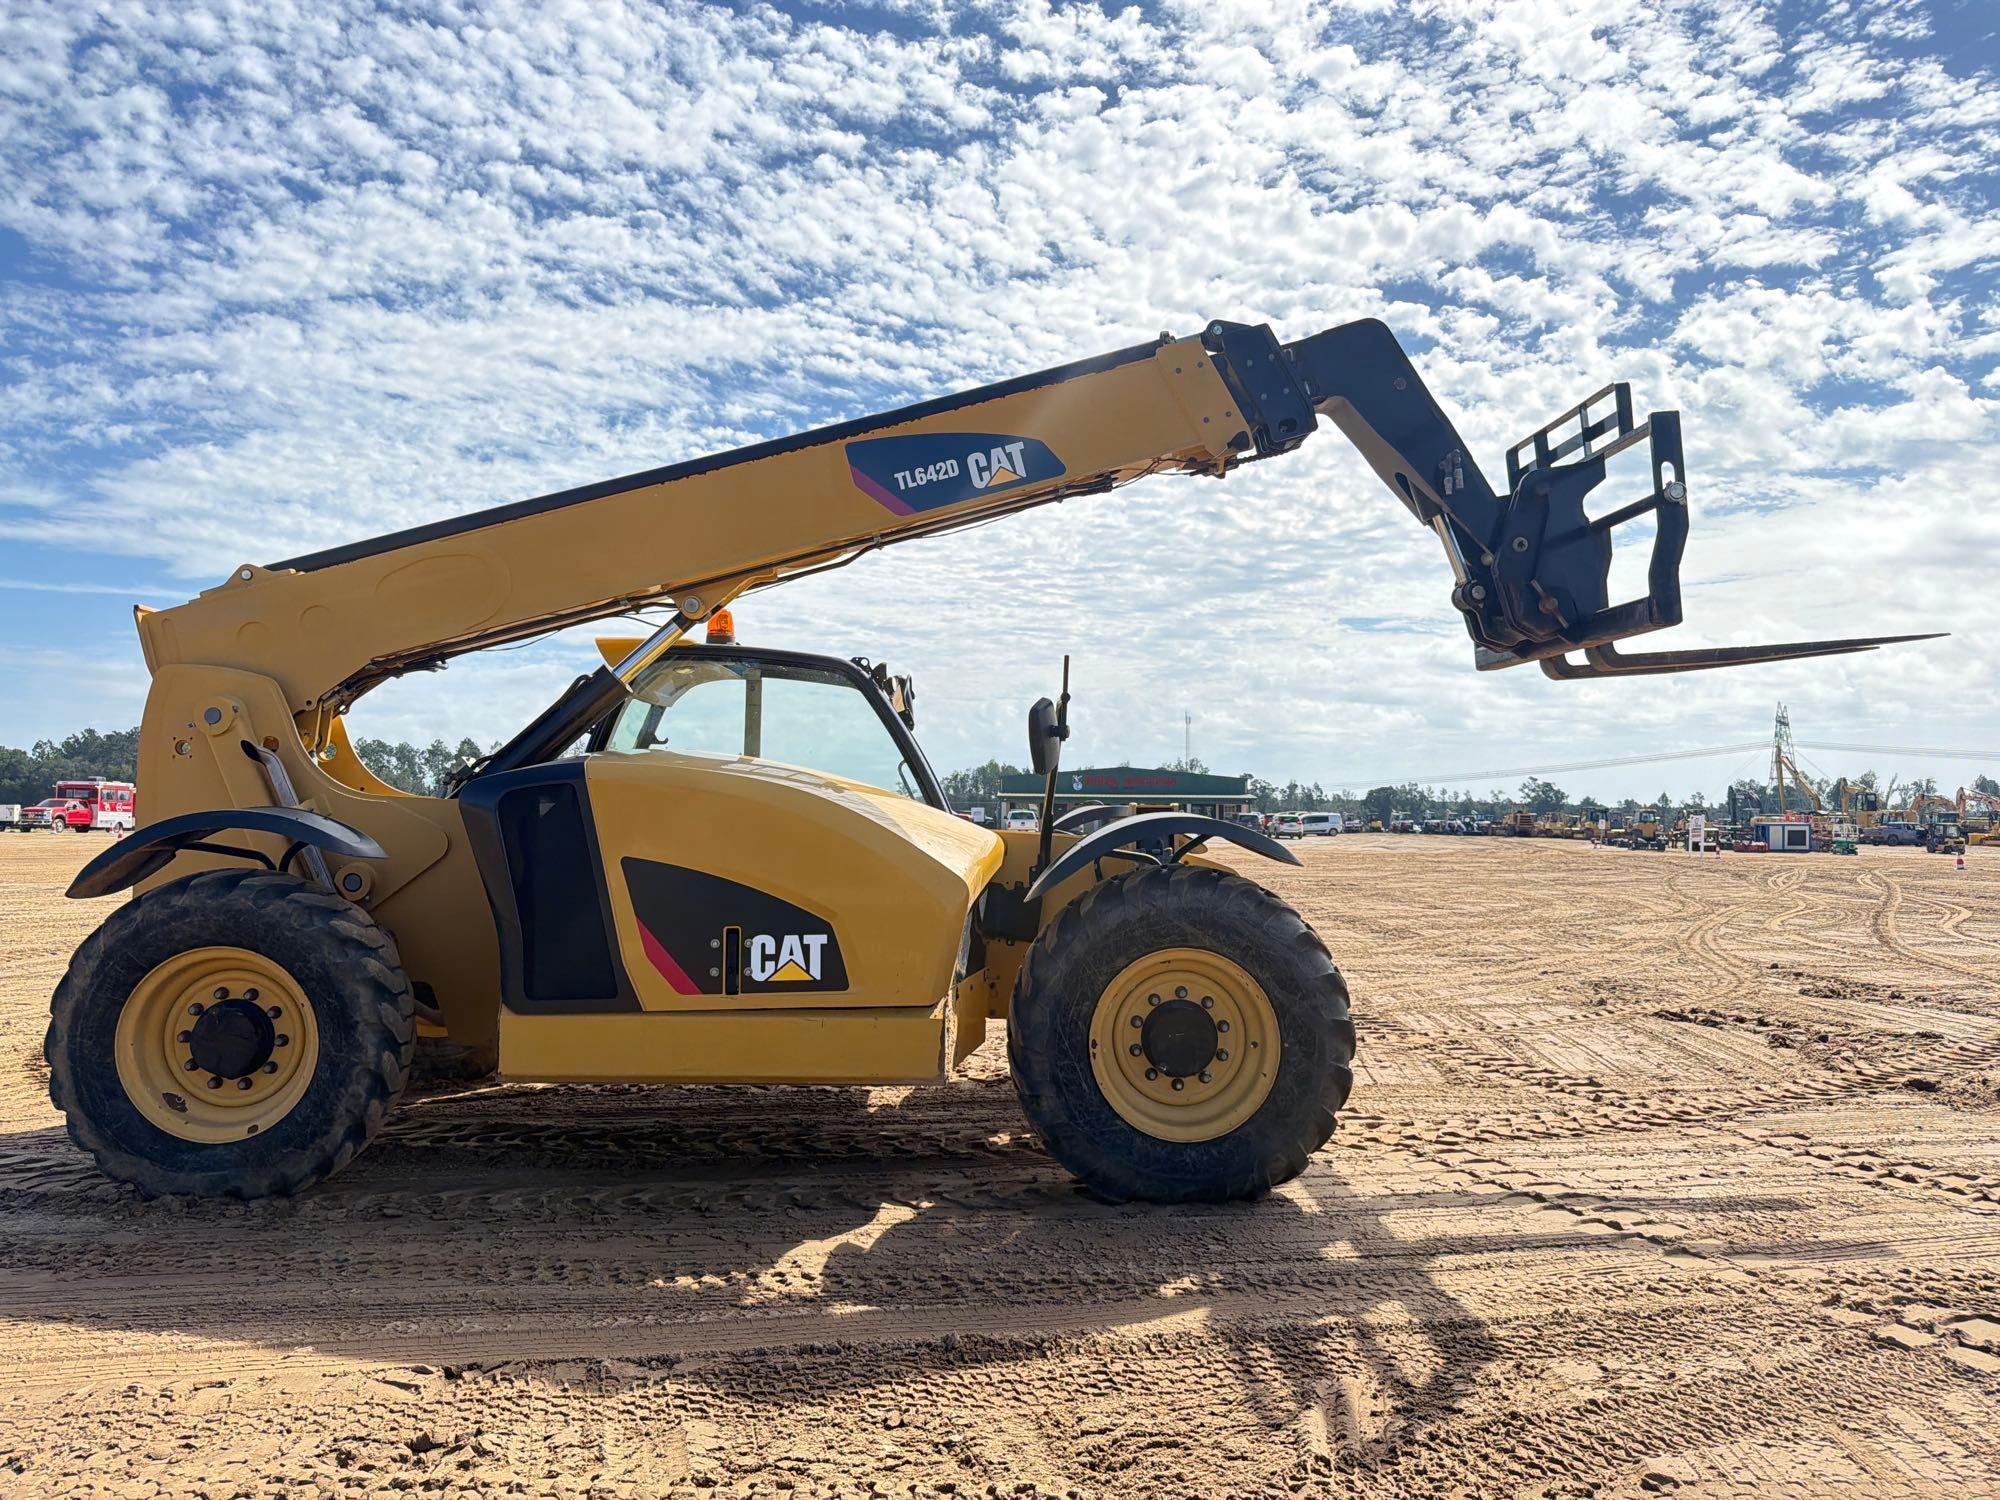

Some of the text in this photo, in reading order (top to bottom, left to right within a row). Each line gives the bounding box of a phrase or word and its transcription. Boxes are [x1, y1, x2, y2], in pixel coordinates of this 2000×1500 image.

[894, 442, 1027, 490] TL642D CAT
[750, 934, 828, 982] CAT
